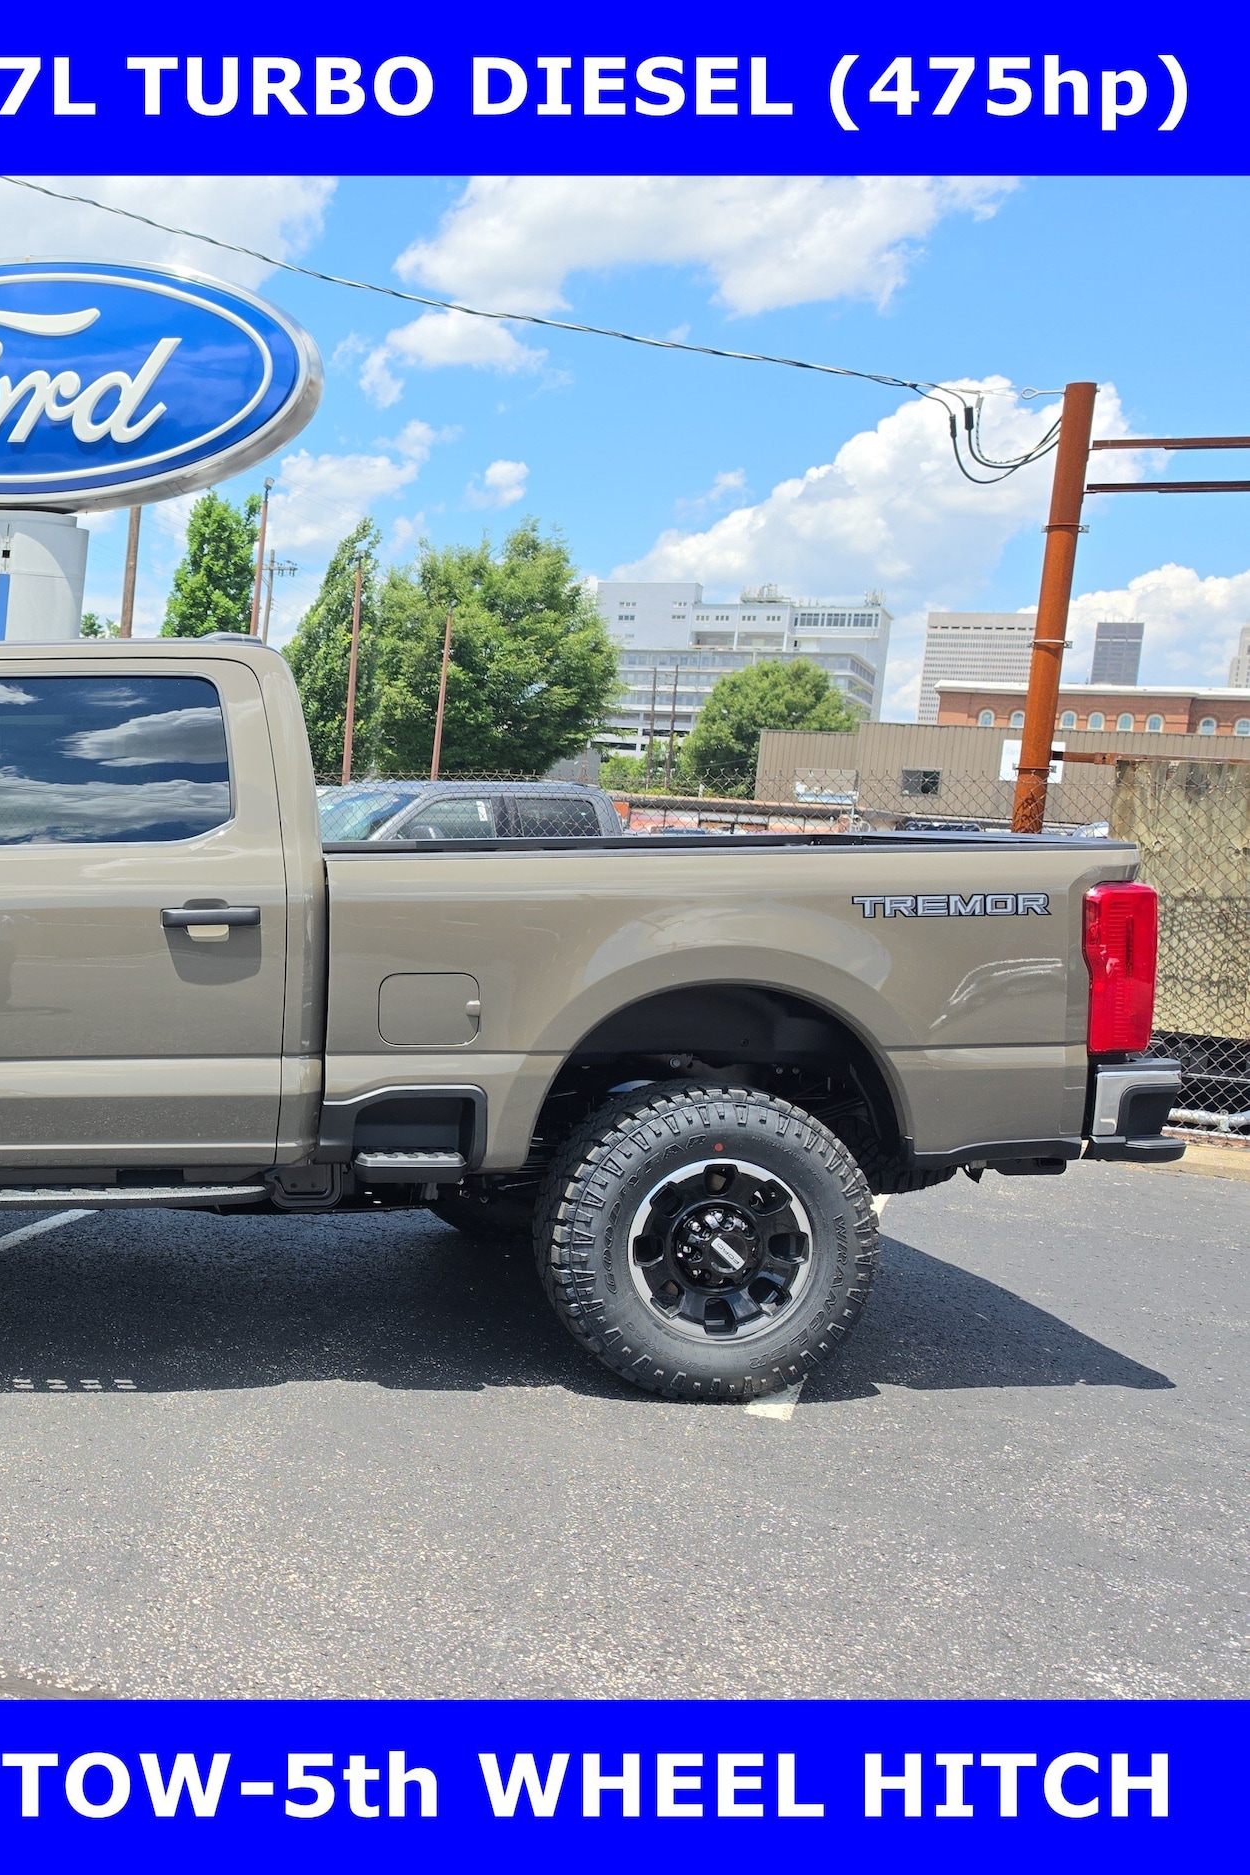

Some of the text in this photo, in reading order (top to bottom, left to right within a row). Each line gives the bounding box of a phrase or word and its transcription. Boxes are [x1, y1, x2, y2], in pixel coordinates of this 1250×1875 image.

[852, 893, 1052, 918] TREMOR
[603, 1134, 708, 1295] GOODYEAR
[716, 1243, 740, 1265] FORD
[748, 1213, 849, 1370] WRANGLER
